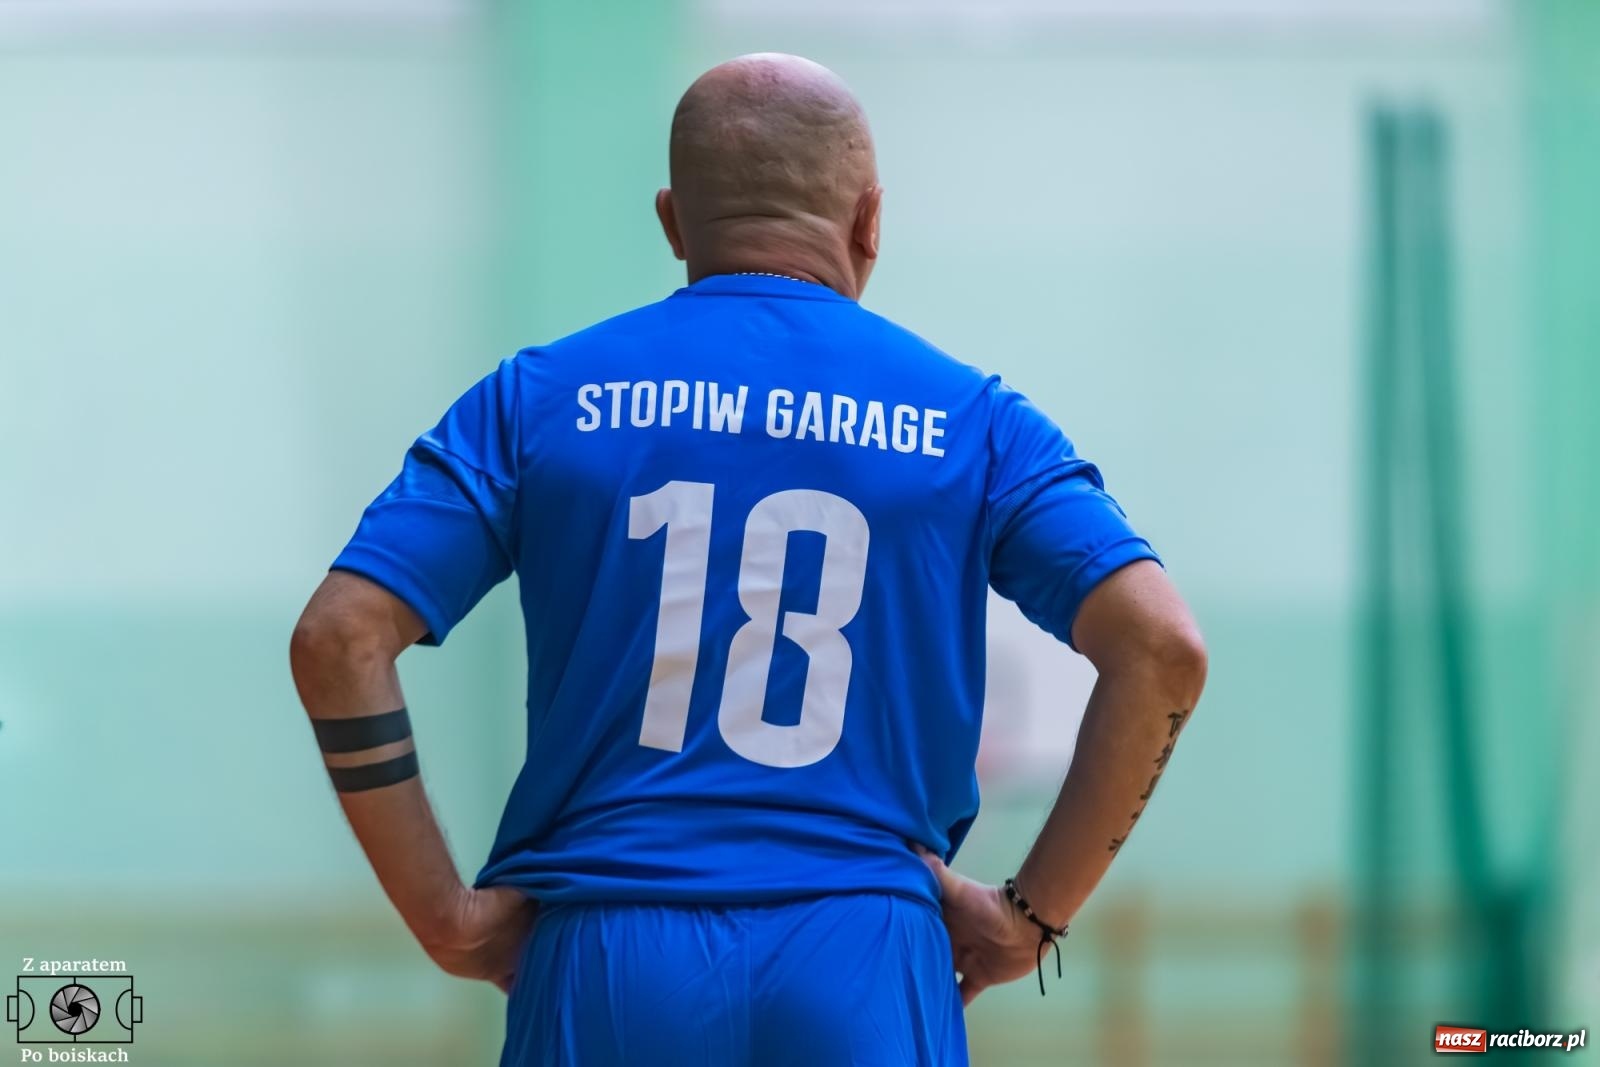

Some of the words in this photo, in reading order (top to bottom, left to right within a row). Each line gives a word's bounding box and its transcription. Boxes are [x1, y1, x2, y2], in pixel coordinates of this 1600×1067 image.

[576, 379, 749, 434] STOPIW
[765, 388, 947, 458] GARAGE
[627, 480, 871, 769] 18
